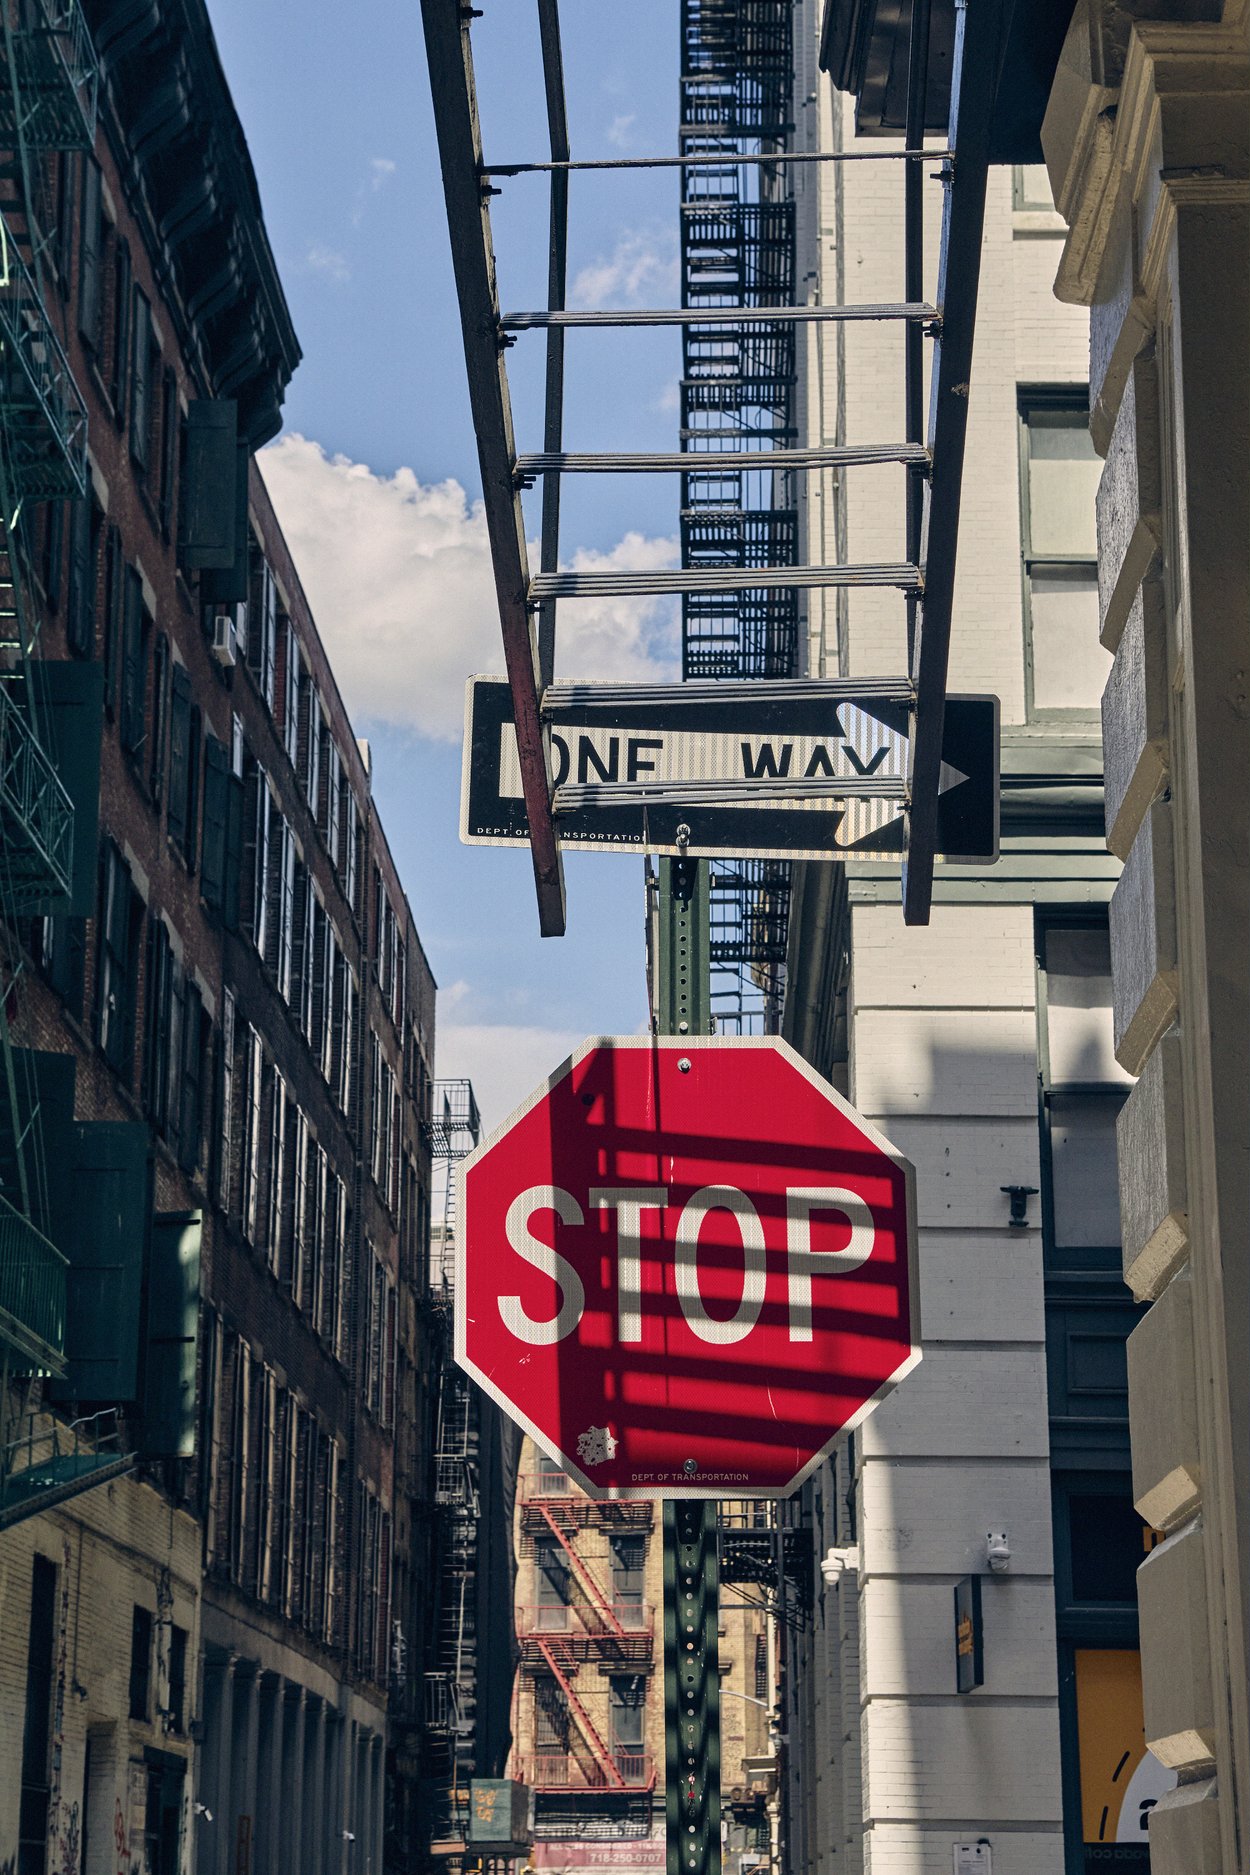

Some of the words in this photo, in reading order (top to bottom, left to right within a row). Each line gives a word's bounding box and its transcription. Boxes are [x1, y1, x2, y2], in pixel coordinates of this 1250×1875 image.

[740, 741, 892, 795] WAY
[497, 1184, 876, 1346] STOP
[657, 1473, 669, 1481] OF
[671, 1473, 749, 1481] TRANSPORTATION
[590, 1853, 662, 1863] 718-250-0707
